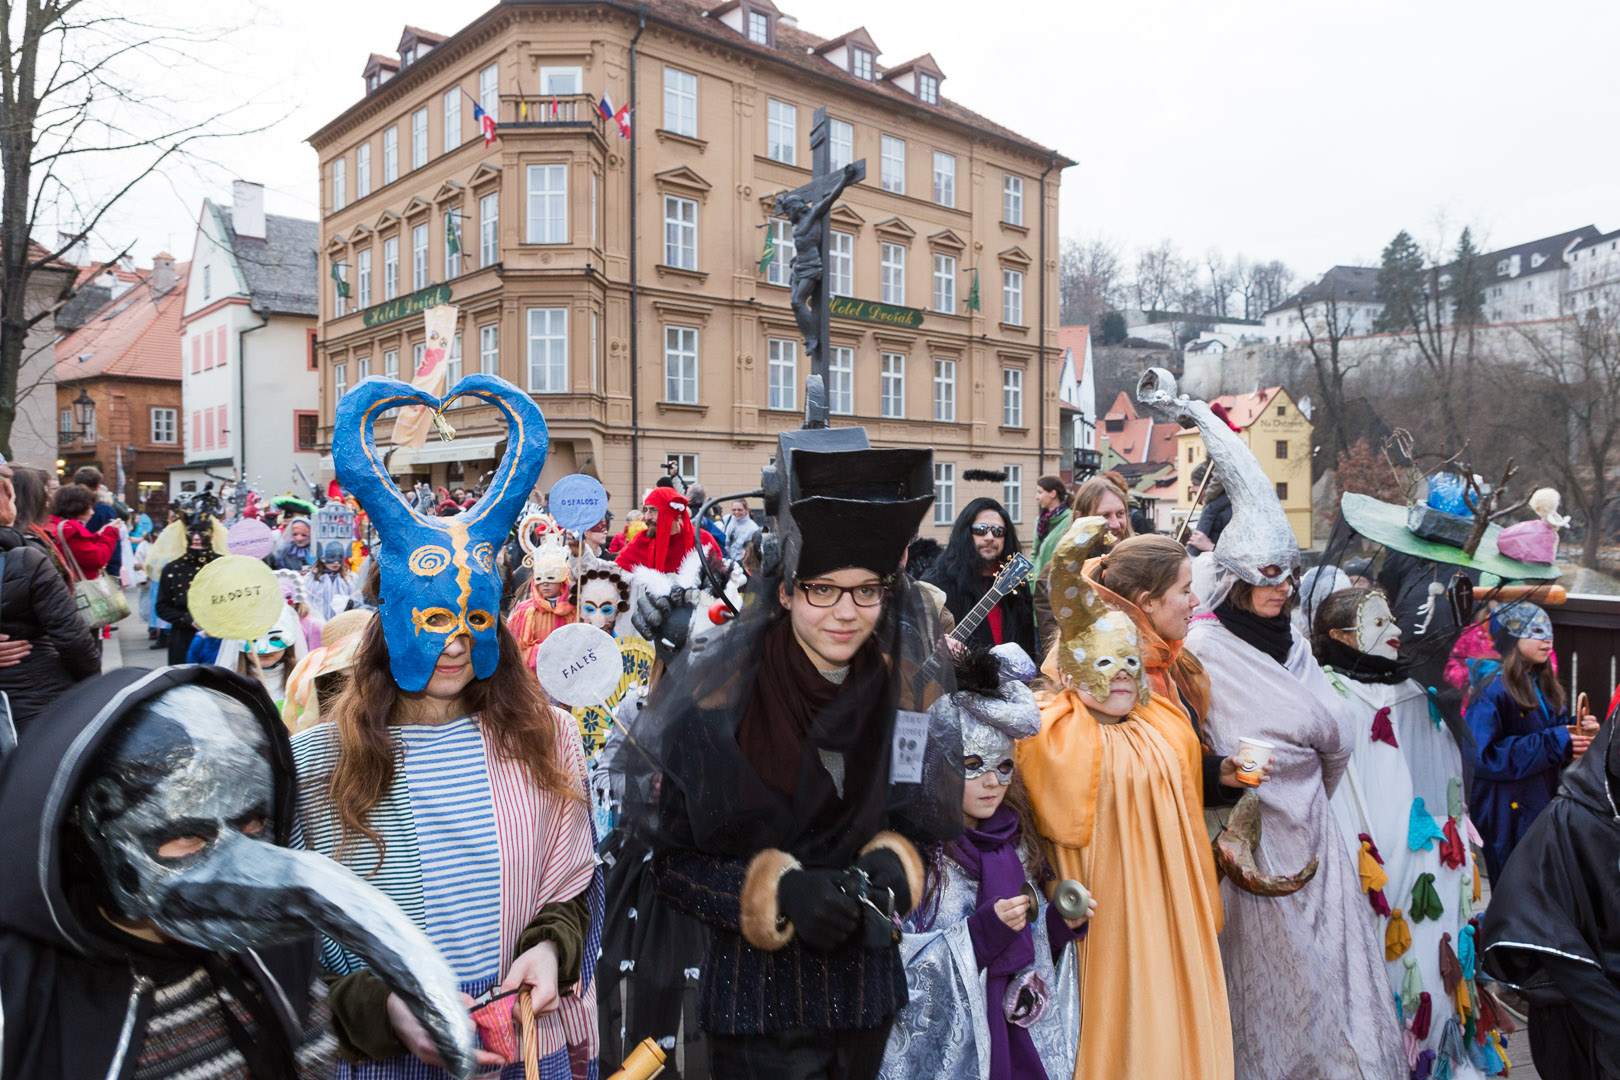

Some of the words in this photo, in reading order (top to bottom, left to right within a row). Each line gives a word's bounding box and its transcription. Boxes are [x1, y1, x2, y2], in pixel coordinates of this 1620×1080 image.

[370, 301, 399, 325] Hotel
[561, 498, 599, 506] OSPALOST
[211, 585, 261, 605] RADOST
[562, 648, 597, 679] FALEŠ
